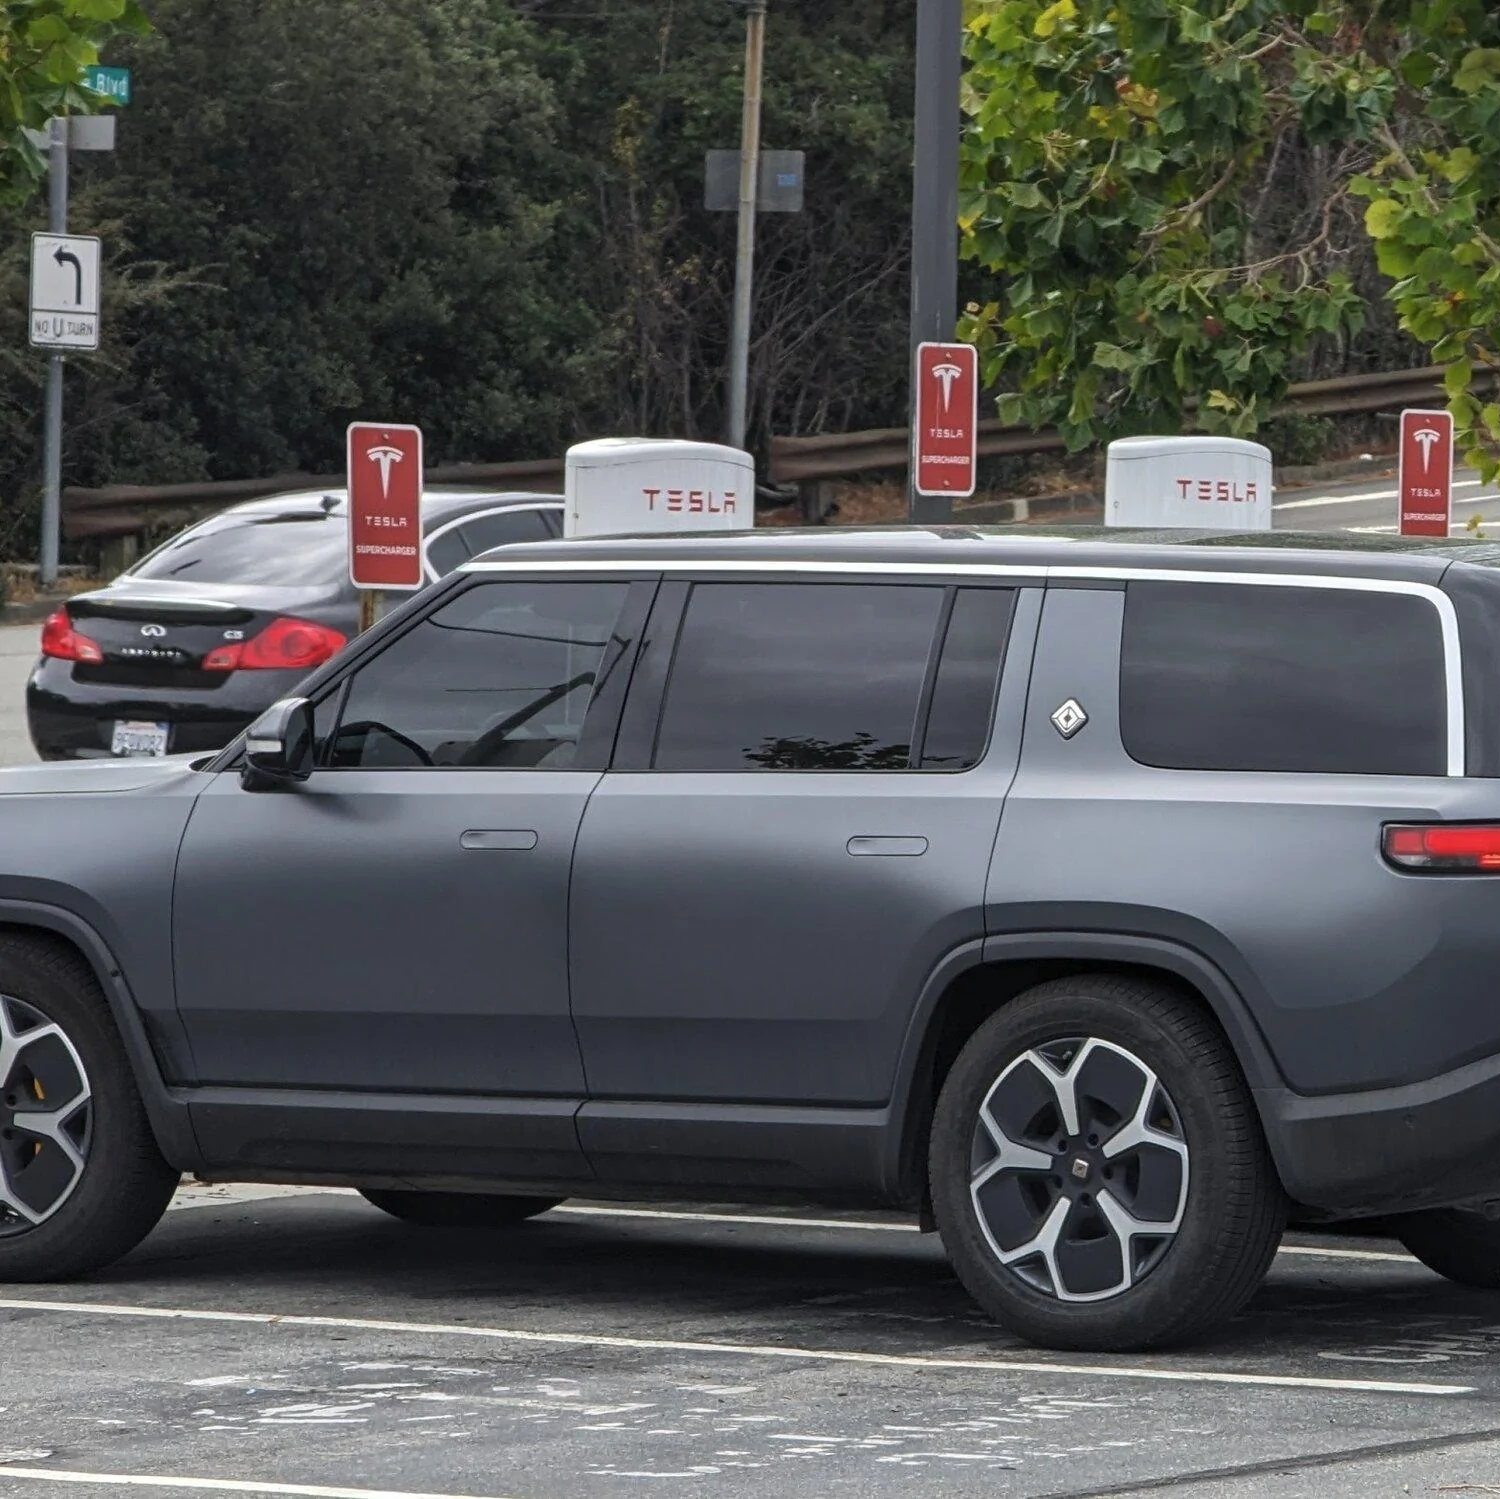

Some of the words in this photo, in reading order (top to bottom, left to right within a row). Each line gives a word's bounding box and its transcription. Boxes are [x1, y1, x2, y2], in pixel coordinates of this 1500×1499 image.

[96, 73, 129, 97] Blvd
[35, 320, 49, 334] NO
[53, 317, 63, 338] U
[67, 321, 94, 336] TURN
[930, 428, 964, 438] TESLA
[922, 455, 970, 465] SUPERCHARGER
[1176, 479, 1257, 503] TESLA
[1410, 487, 1441, 498] TESLA
[642, 488, 736, 514] TESLA
[365, 515, 408, 527] TESLA
[355, 544, 417, 556] SUPERCHARGER
